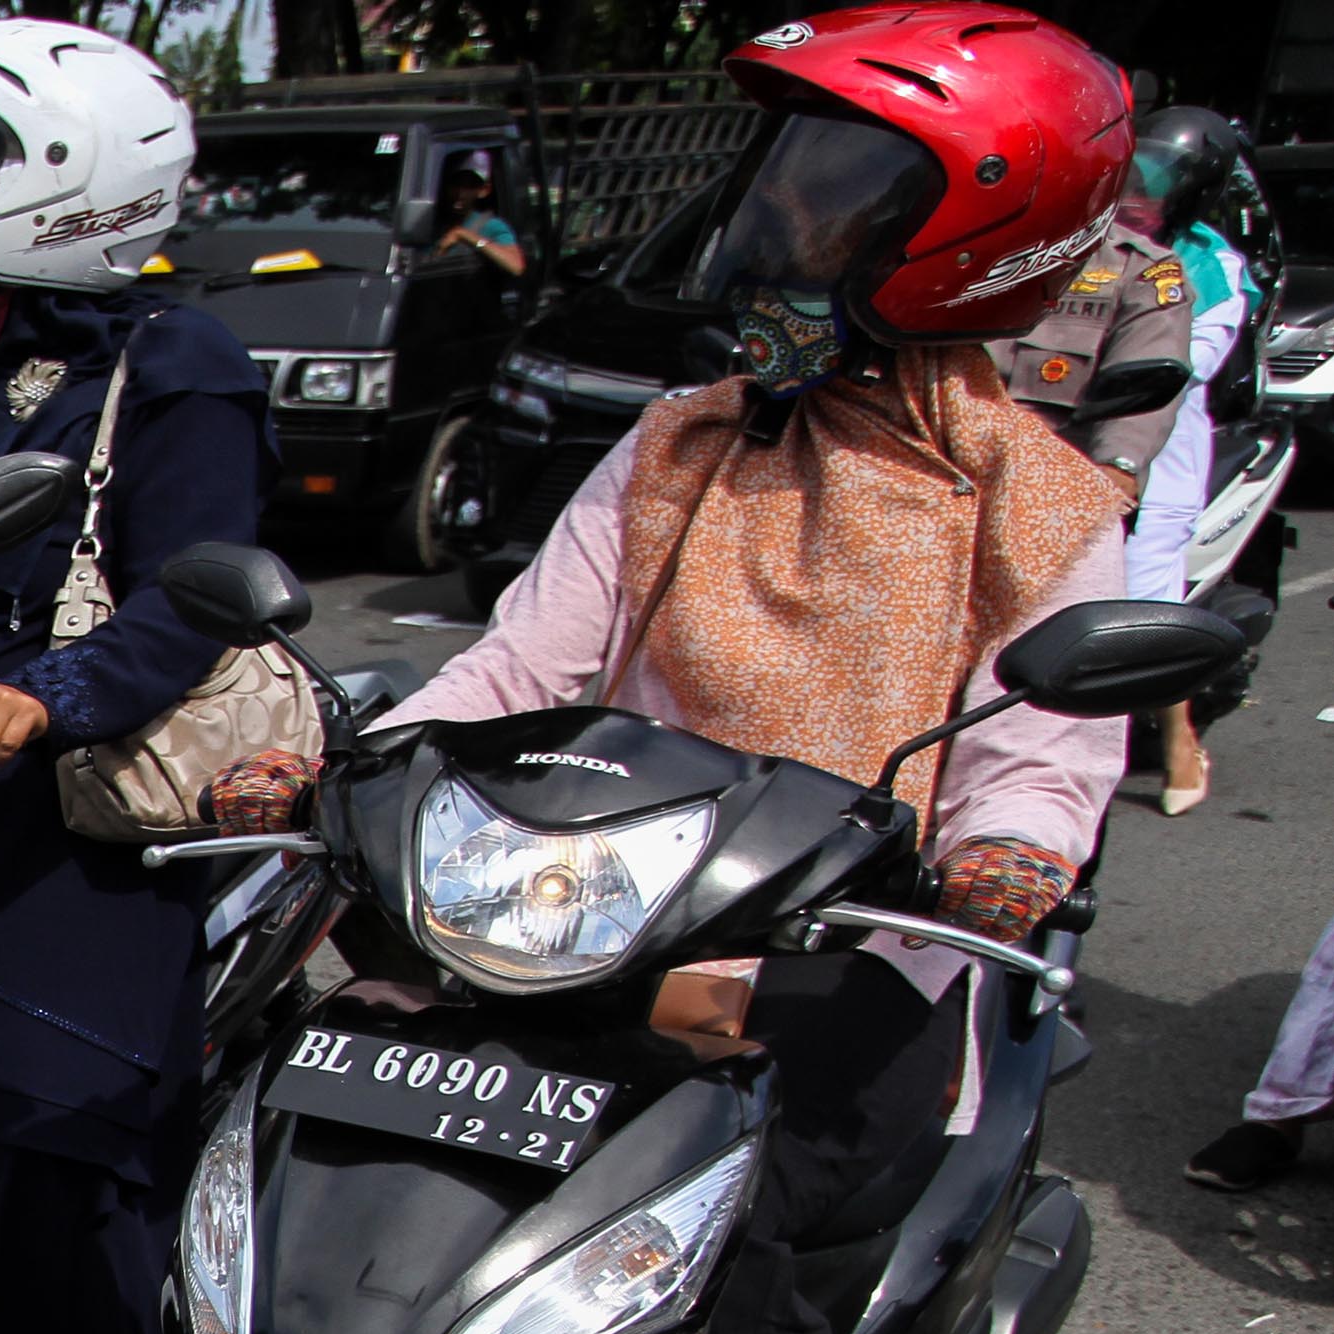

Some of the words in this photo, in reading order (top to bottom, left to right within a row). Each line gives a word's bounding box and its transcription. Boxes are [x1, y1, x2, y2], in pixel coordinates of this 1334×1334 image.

[514, 753, 631, 779] HONDA
[287, 1029, 353, 1075] BL
[372, 1045, 509, 1102] 6090
[522, 1074, 606, 1124] NS
